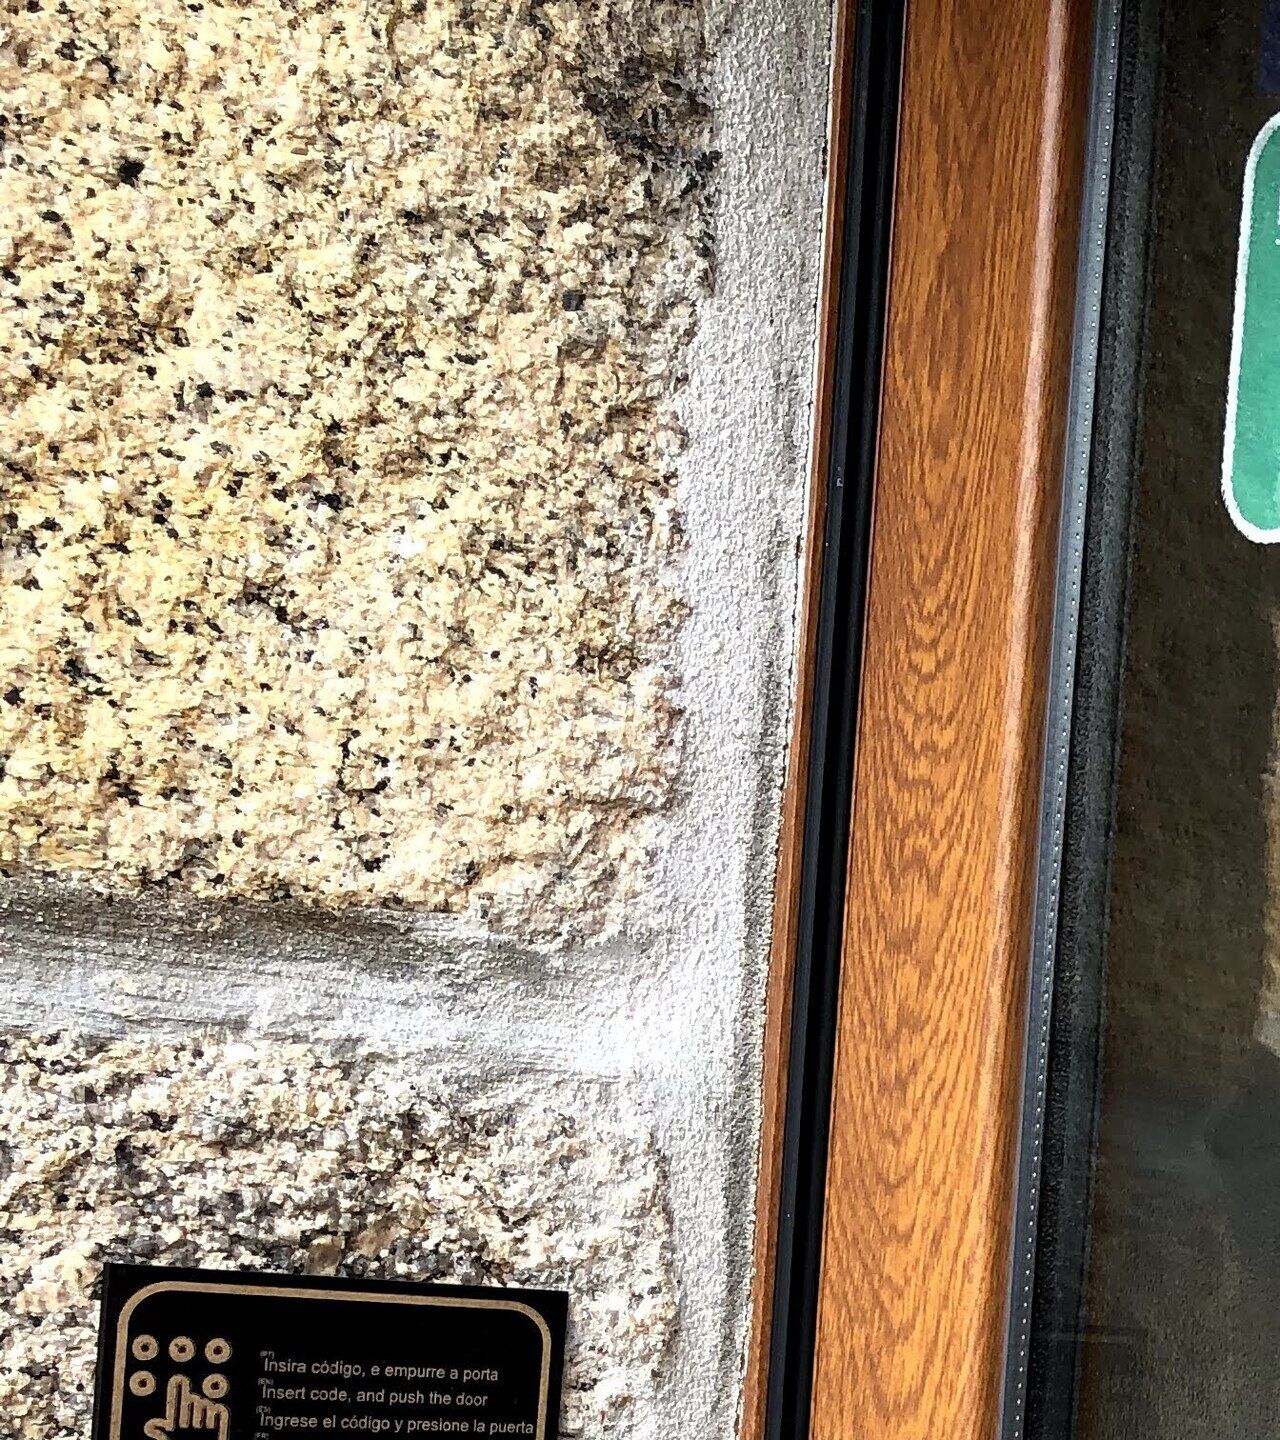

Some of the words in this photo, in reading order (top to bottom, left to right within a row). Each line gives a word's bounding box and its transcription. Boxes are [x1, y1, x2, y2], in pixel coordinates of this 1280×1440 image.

[264, 1358, 306, 1373] Insira
[311, 1360, 366, 1378] código,
[371, 1365, 380, 1376] e
[384, 1365, 445, 1380] empurre
[449, 1368, 459, 1380] a
[463, 1368, 499, 1383] porta
[262, 1384, 306, 1400] Insert
[310, 1386, 351, 1402] code,
[356, 1388, 385, 1403] and
[389, 1390, 425, 1406] push
[429, 1391, 452, 1405] the
[455, 1392, 488, 1406] door
[260, 1412, 318, 1430] Ingrese
[322, 1414, 336, 1428] el
[340, 1415, 390, 1432] código
[394, 1419, 404, 1433] y
[407, 1418, 469, 1433] presione
[473, 1419, 485, 1432] la
[489, 1421, 534, 1435] puerta
